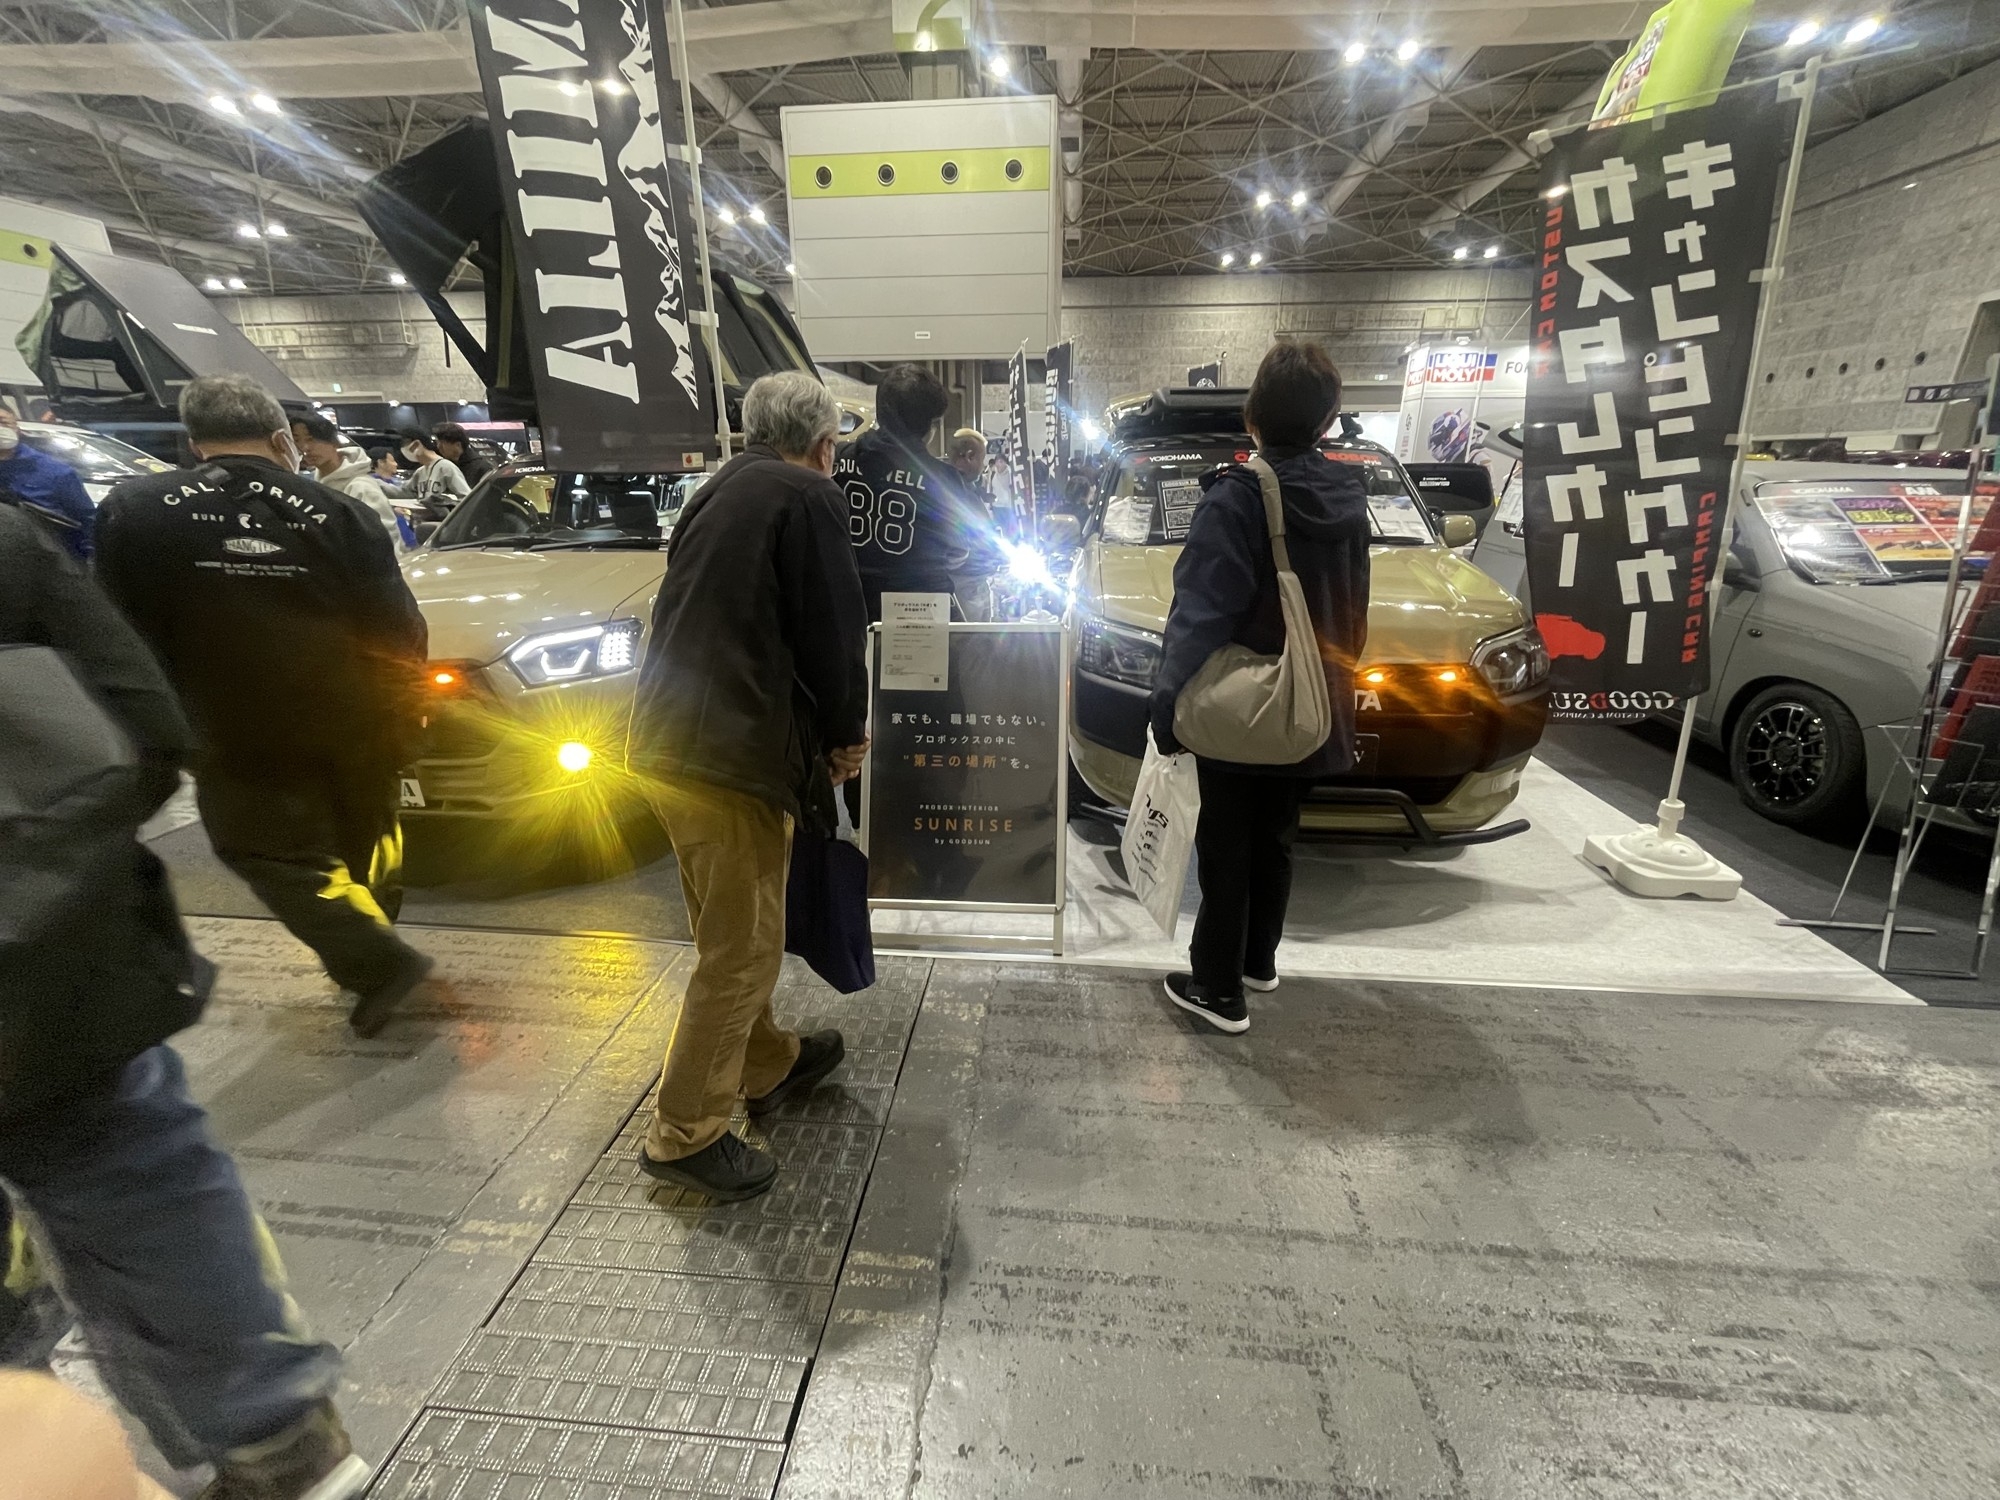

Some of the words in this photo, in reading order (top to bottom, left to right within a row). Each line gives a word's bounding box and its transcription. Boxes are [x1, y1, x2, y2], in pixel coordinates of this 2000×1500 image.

[1433, 369, 1474, 381] MOLY
[1149, 453, 1202, 461] YOKOHAMA
[844, 480, 917, 555] 88
[914, 734, 1016, 745] プロボックスの中に
[914, 817, 1012, 832] SUNRISE
